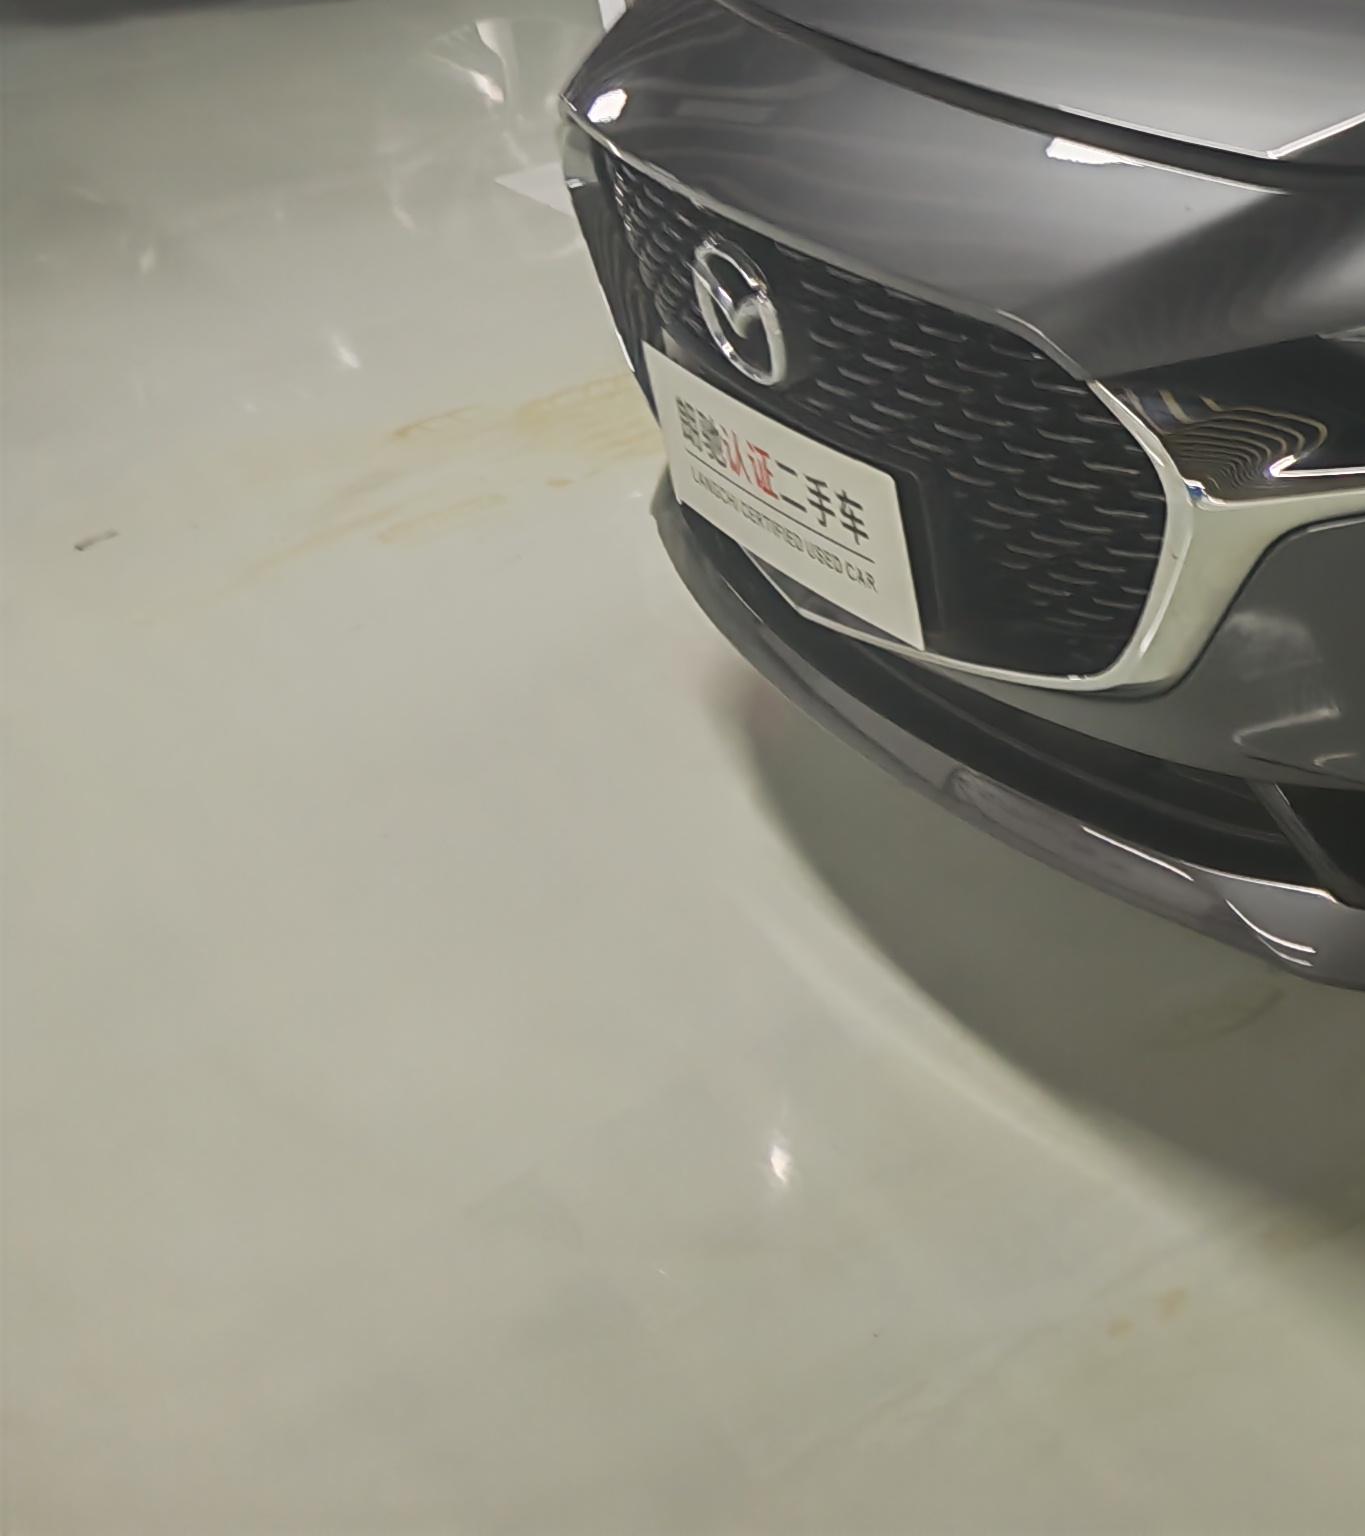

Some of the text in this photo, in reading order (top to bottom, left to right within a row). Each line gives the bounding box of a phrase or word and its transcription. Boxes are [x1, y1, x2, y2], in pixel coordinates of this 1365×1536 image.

[740, 503, 803, 554] CERTIFIED
[805, 536, 844, 575] USED
[846, 558, 880, 594] CAR
